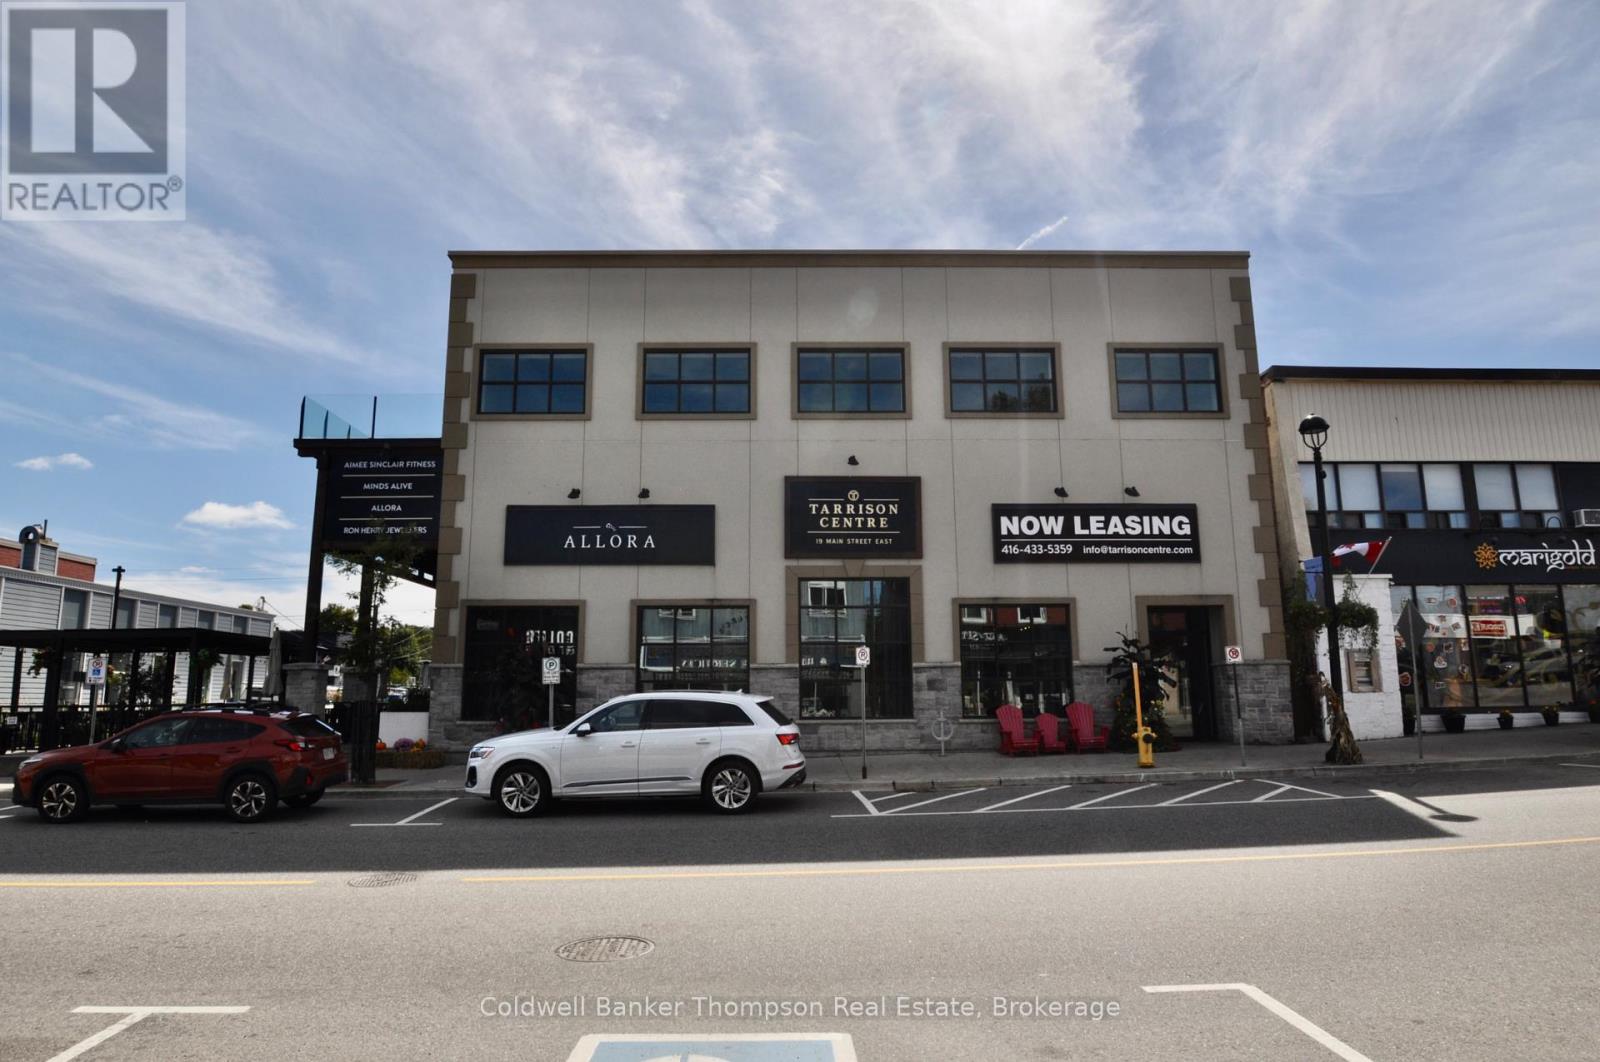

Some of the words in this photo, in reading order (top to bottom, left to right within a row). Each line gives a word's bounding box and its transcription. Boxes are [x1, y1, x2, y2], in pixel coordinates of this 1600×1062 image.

[343, 461, 368, 469] AIMEE
[369, 461, 405, 469] SINCLAIR
[406, 460, 437, 468] FITNESS
[390, 482, 413, 490] ALIVE
[371, 504, 402, 512] ALLORA
[808, 503, 899, 515] TARRISON
[819, 517, 889, 528] CENTRE
[1000, 515, 1064, 536] NOW
[1073, 515, 1191, 536] LEASING
[563, 534, 656, 549] ALLORA
[1001, 544, 1073, 555] 416-433-5359
[1082, 545, 1193, 555] info@tarrisoncentre.com
[1498, 539, 1596, 573] marigold
